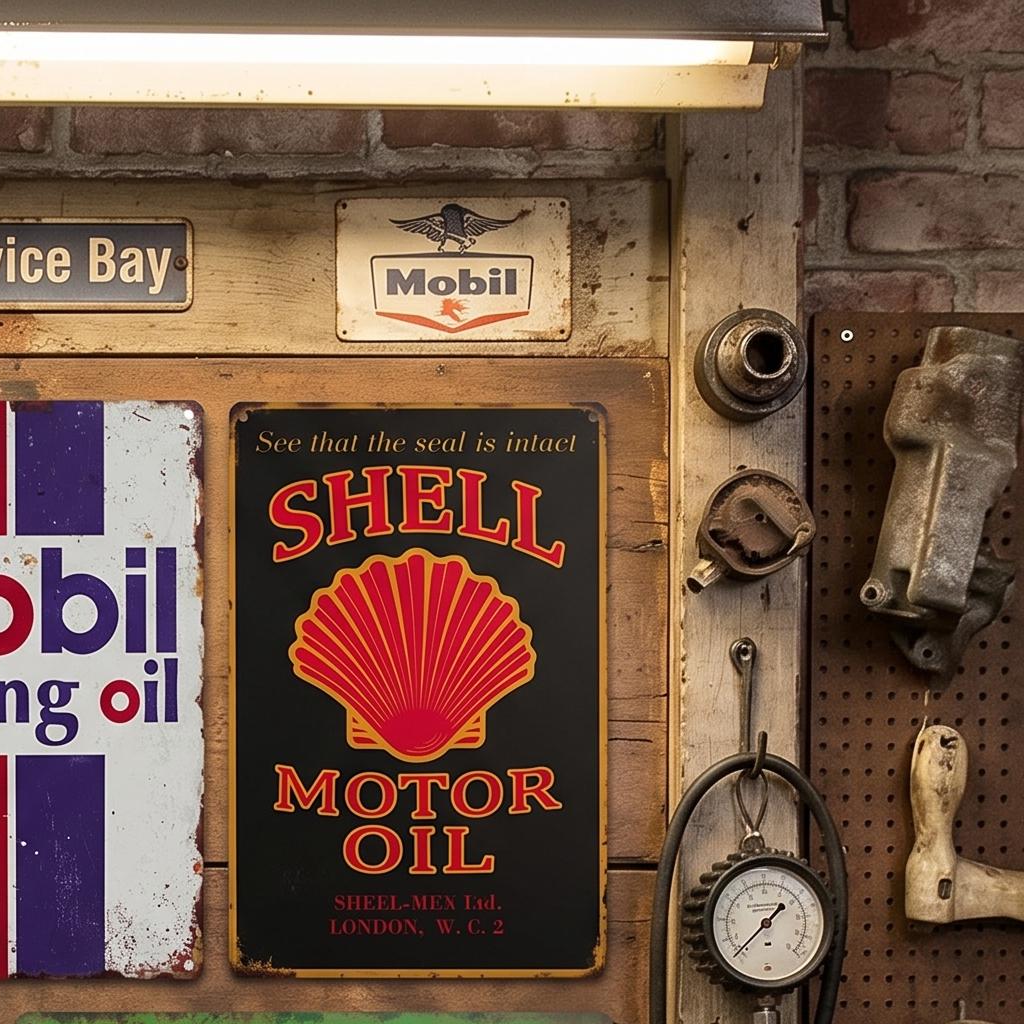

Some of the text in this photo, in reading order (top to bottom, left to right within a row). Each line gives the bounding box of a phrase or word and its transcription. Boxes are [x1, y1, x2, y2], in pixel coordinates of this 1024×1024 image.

[88, 236, 173, 295] Bay
[386, 267, 517, 296] Mobil
[256, 430, 576, 453] See that the seal is intact
[268, 465, 565, 568] SHELL
[99, 658, 179, 724] oil
[273, 764, 563, 820] MOTOR
[343, 824, 496, 875] OIL
[328, 918, 425, 937] LONDON,
[492, 919, 504, 935] 2
